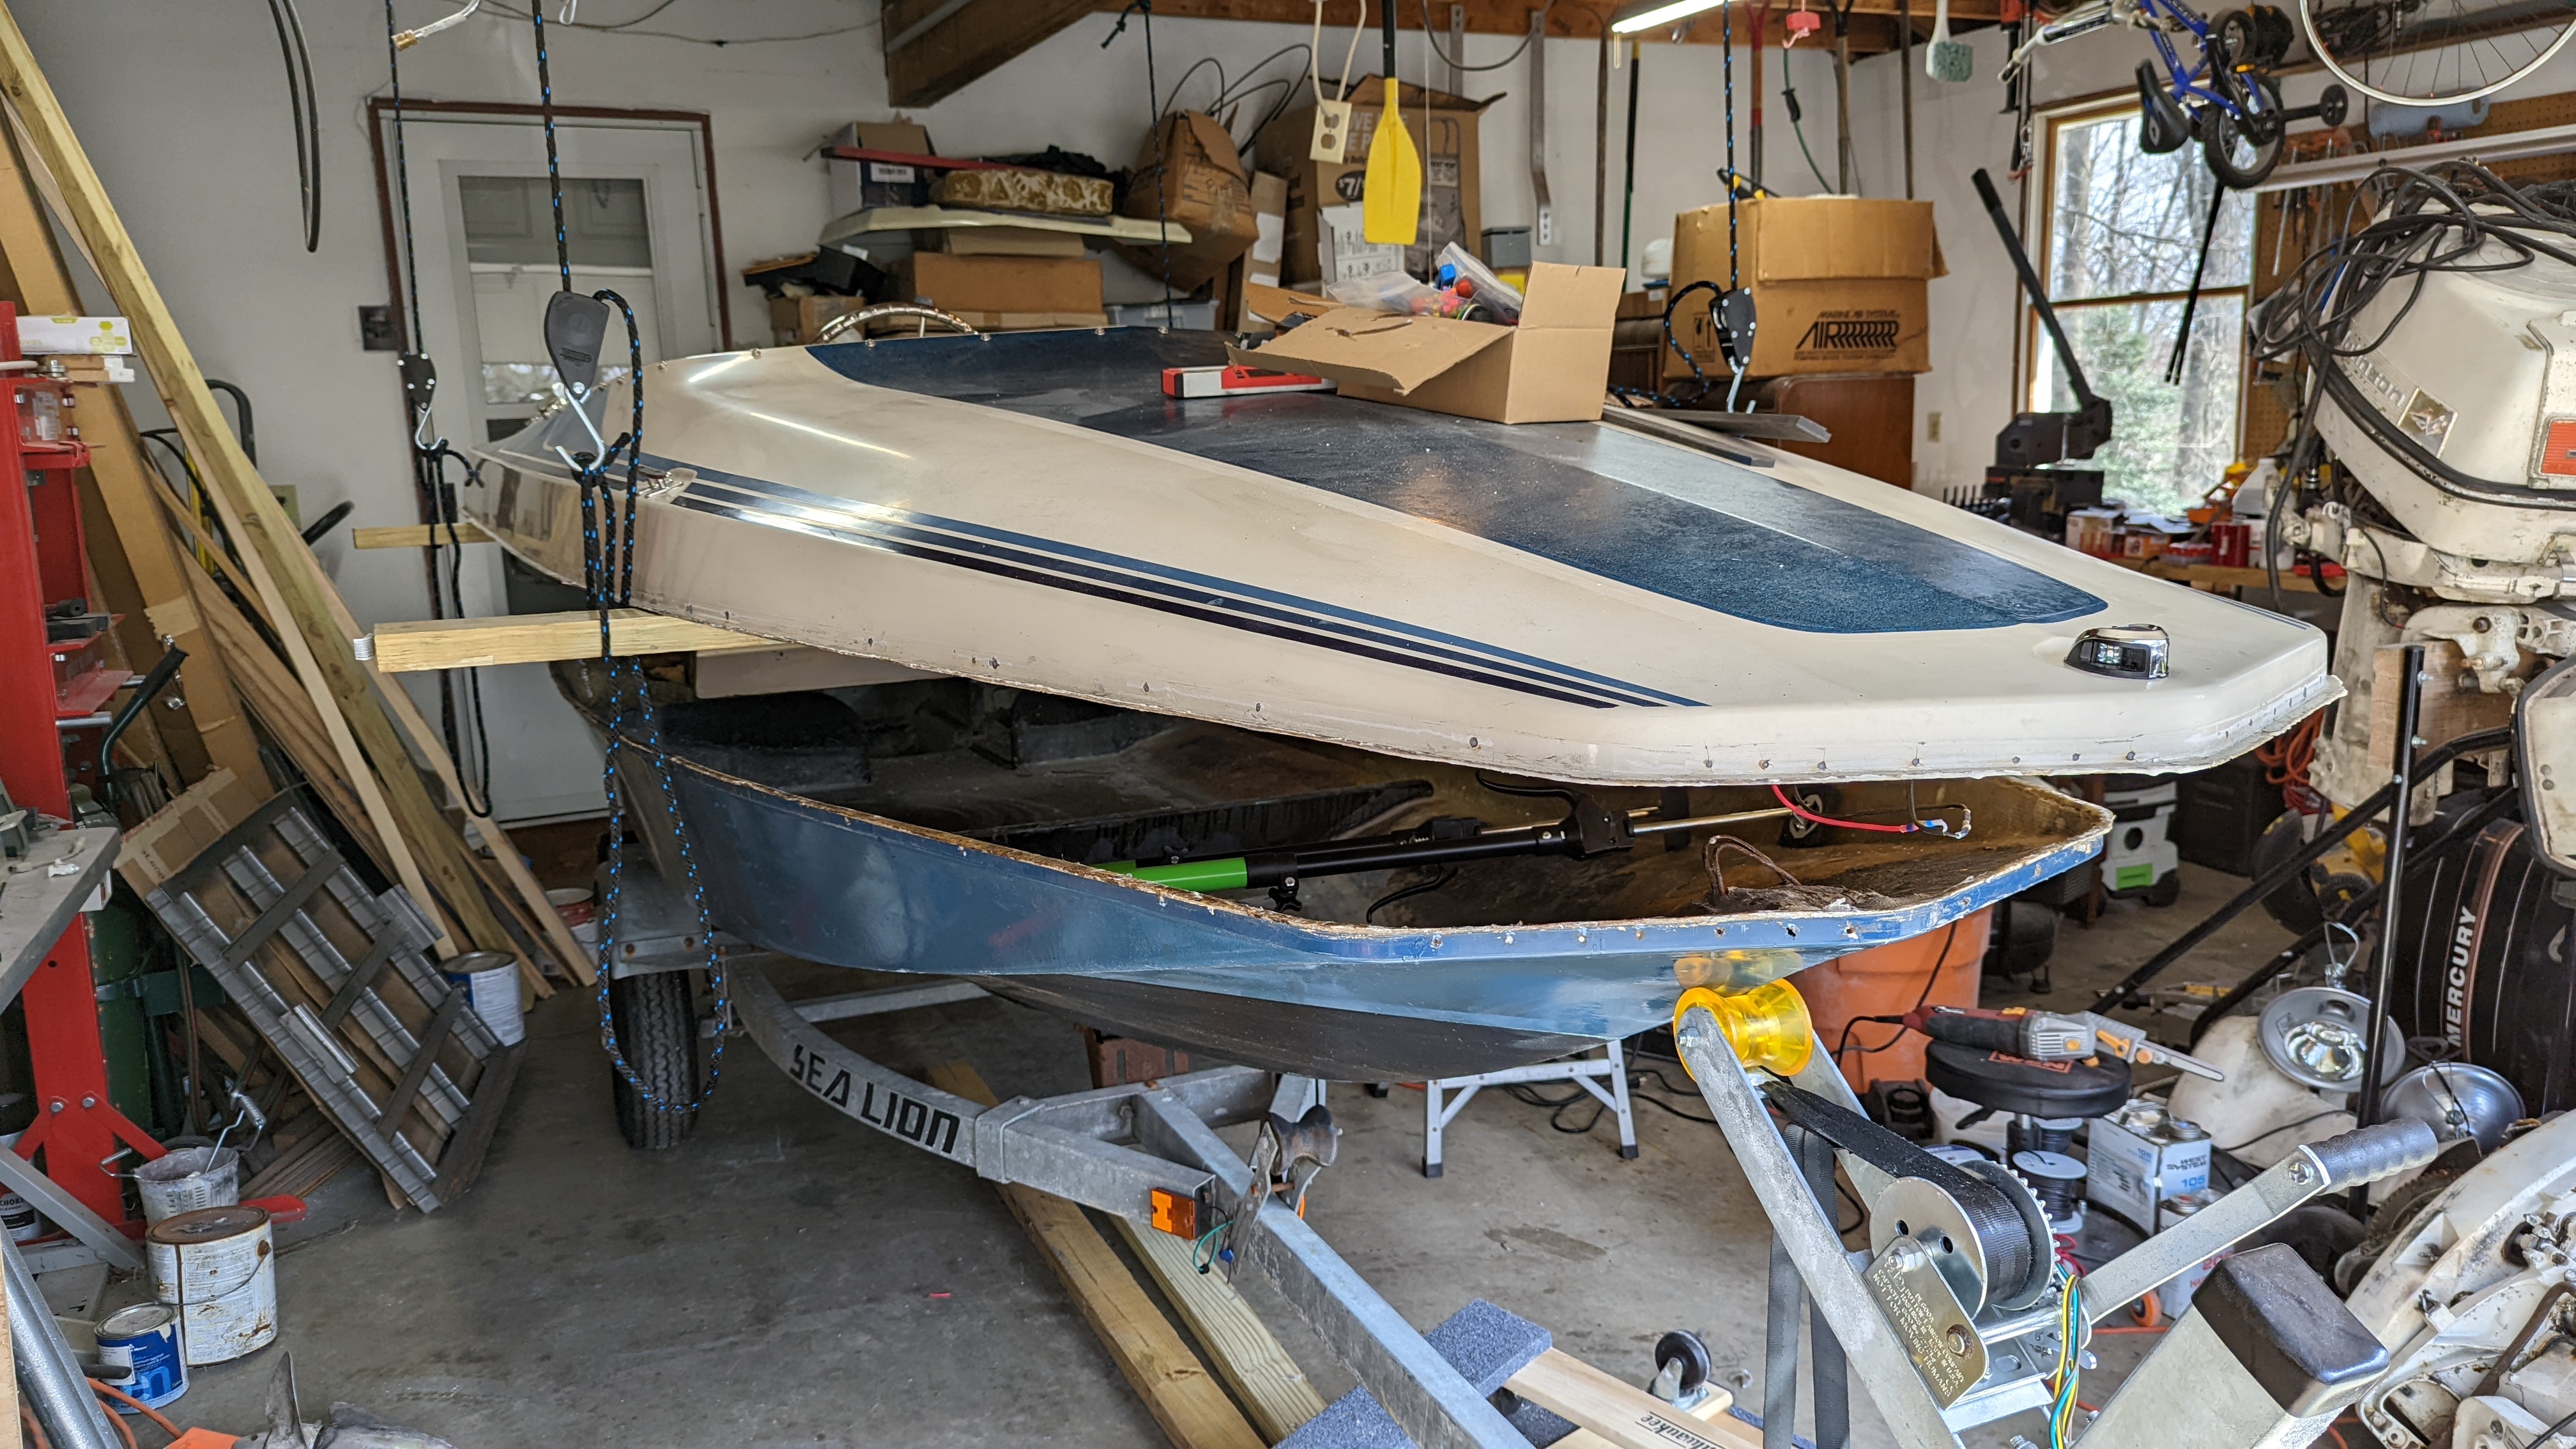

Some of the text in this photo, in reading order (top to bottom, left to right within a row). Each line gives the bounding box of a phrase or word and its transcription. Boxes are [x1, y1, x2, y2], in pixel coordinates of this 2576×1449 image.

[2338, 329, 2405, 408] ohnson
[2446, 905, 2476, 1047] MERCURY
[790, 1044, 961, 1154] SEA LION
[2166, 1160, 2207, 1170] SYSTEM
[2180, 1154, 2207, 1164] WEST
[2181, 1175, 2206, 1187] 105
[1877, 1268, 1902, 1305] CAPACITY
[1900, 1307, 1914, 1325] 600
[1872, 1273, 1887, 1293] NOT
[1885, 1296, 1901, 1316] FOR
[1898, 1317, 1925, 1354] MOVING
[1922, 1356, 1952, 1398] HUMANS
[1941, 1349, 1965, 1383] COMPANY
[1641, 1414, 1717, 1449] ilwaukee
